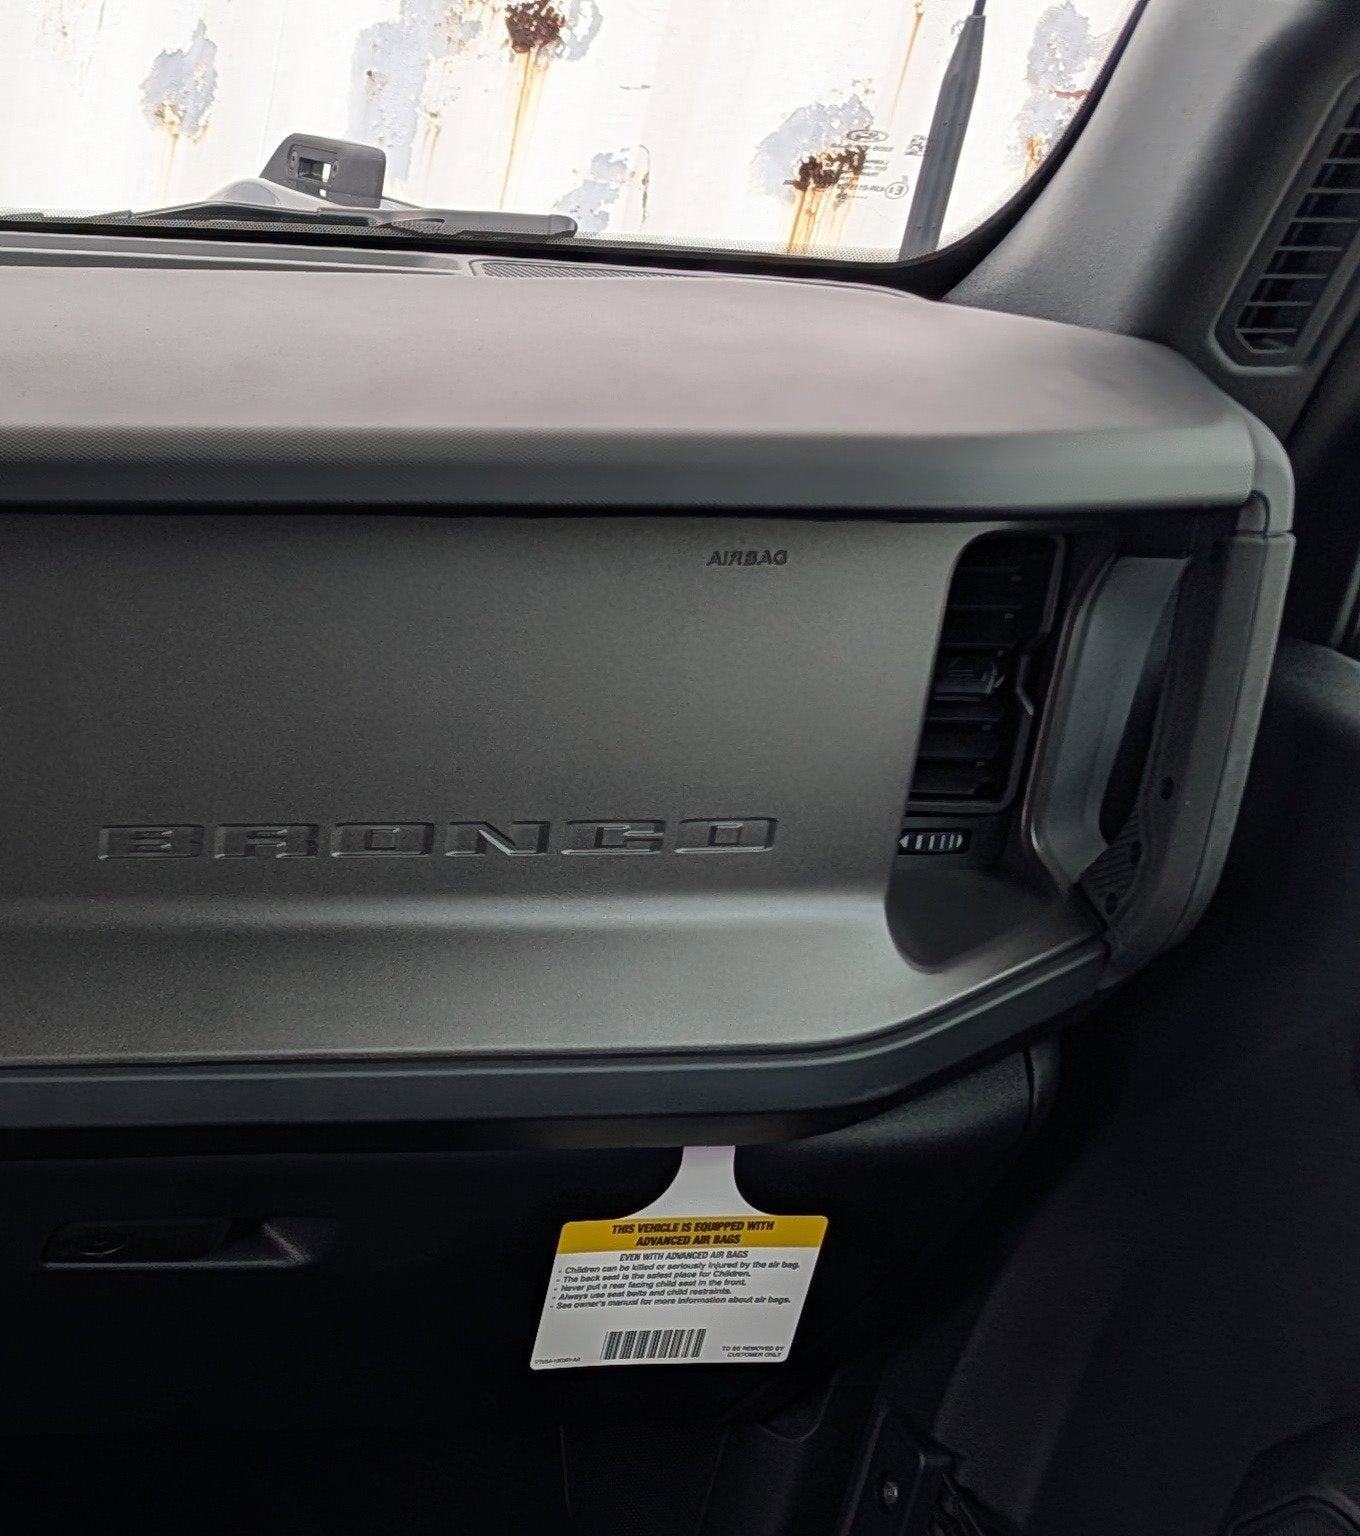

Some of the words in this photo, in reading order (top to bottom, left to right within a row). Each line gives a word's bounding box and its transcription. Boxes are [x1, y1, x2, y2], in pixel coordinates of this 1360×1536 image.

[705, 549, 788, 567] AIRBAG
[96, 816, 779, 861] BRONCO
[611, 1223, 636, 1235] THIS
[637, 1222, 680, 1234] VEHICLE
[680, 1221, 692, 1233] IS
[693, 1220, 745, 1232] EQUIPPED
[746, 1220, 775, 1231] WITH
[635, 1235, 691, 1247] ADVANCED
[692, 1234, 711, 1246] AIR
[712, 1233, 742, 1245] BAGS
[619, 1253, 641, 1262] EVEN
[642, 1252, 665, 1261] WITH
[665, 1251, 709, 1260] ADVANCED
[710, 1250, 726, 1259] AIR
[726, 1250, 749, 1259] BAGS
